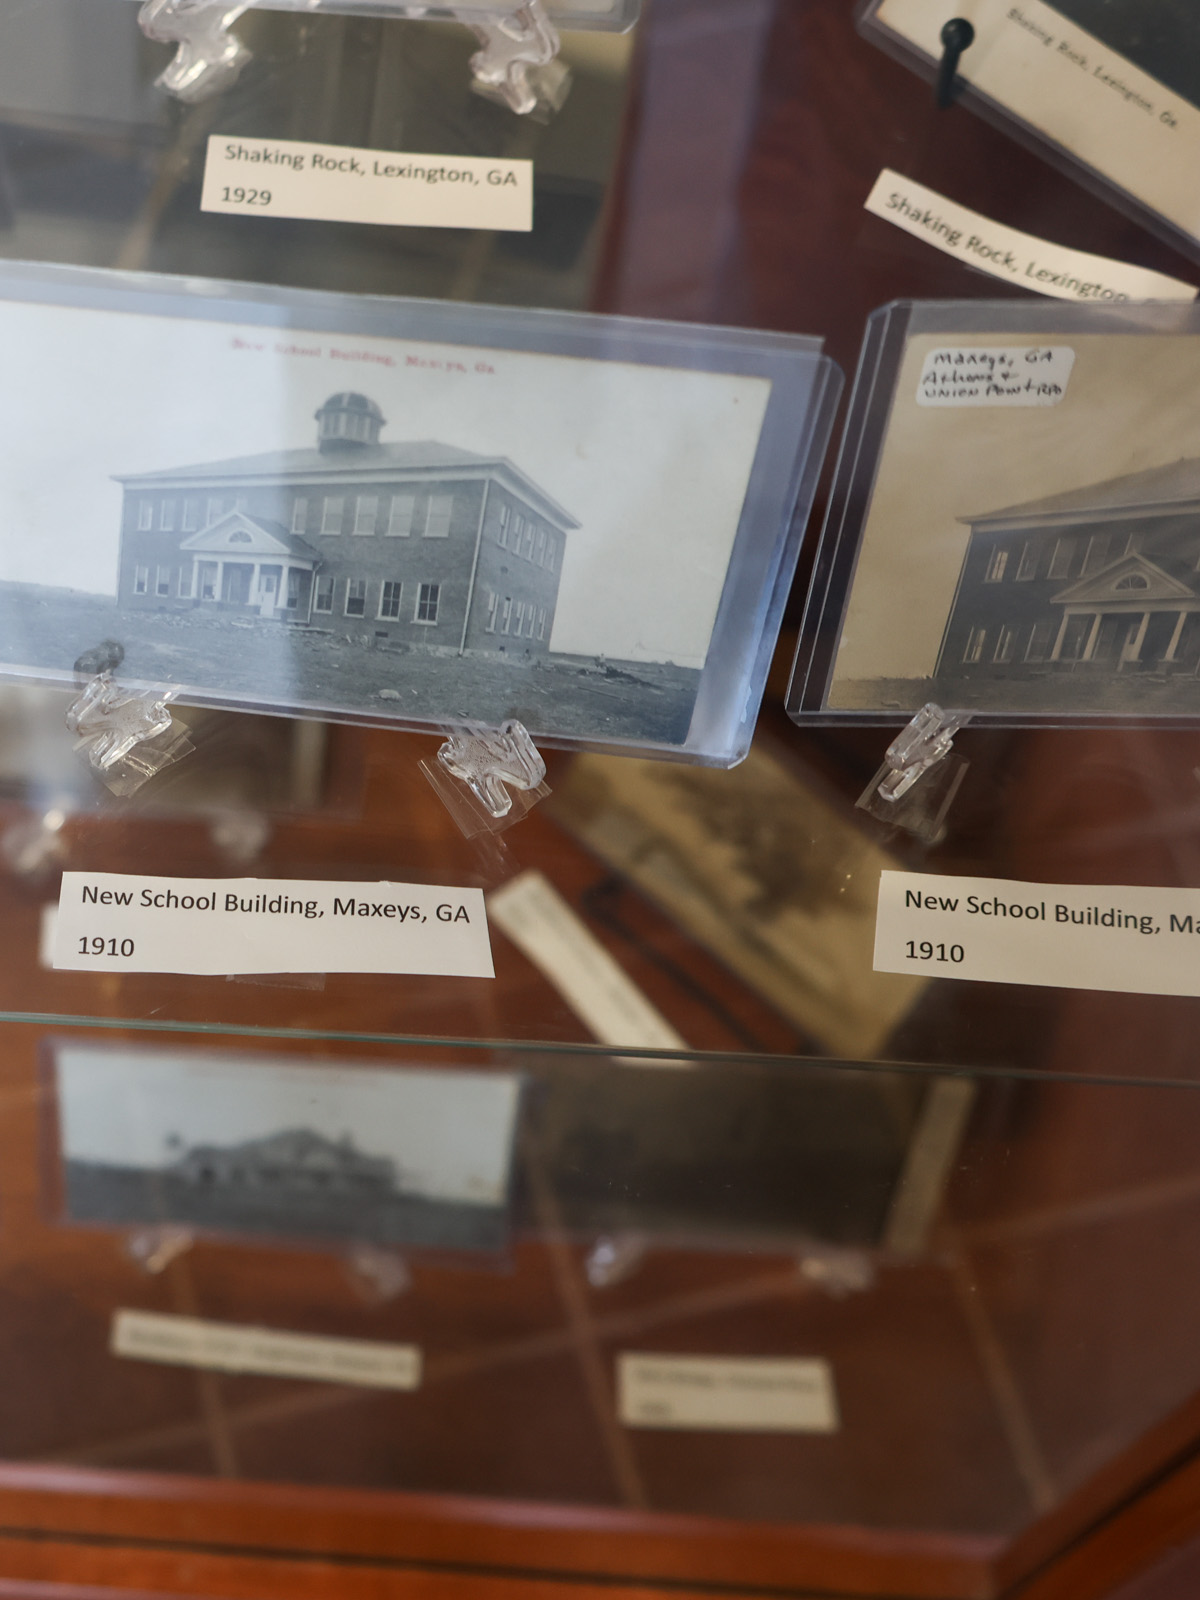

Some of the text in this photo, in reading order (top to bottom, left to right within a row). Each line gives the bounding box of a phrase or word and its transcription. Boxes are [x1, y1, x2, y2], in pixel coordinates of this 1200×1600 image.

[224, 144, 518, 187] Shaking Rock, Lexington, GA
[222, 187, 272, 206] 1929
[885, 192, 962, 247] Shaking
[965, 235, 1018, 272] Rock,
[82, 885, 470, 924] New School Building, Maxeys, GA
[905, 889, 959, 912] New
[966, 895, 1045, 921] School
[1055, 903, 1161, 935] Building,
[78, 936, 135, 957] 1910
[905, 940, 965, 963] 1910
